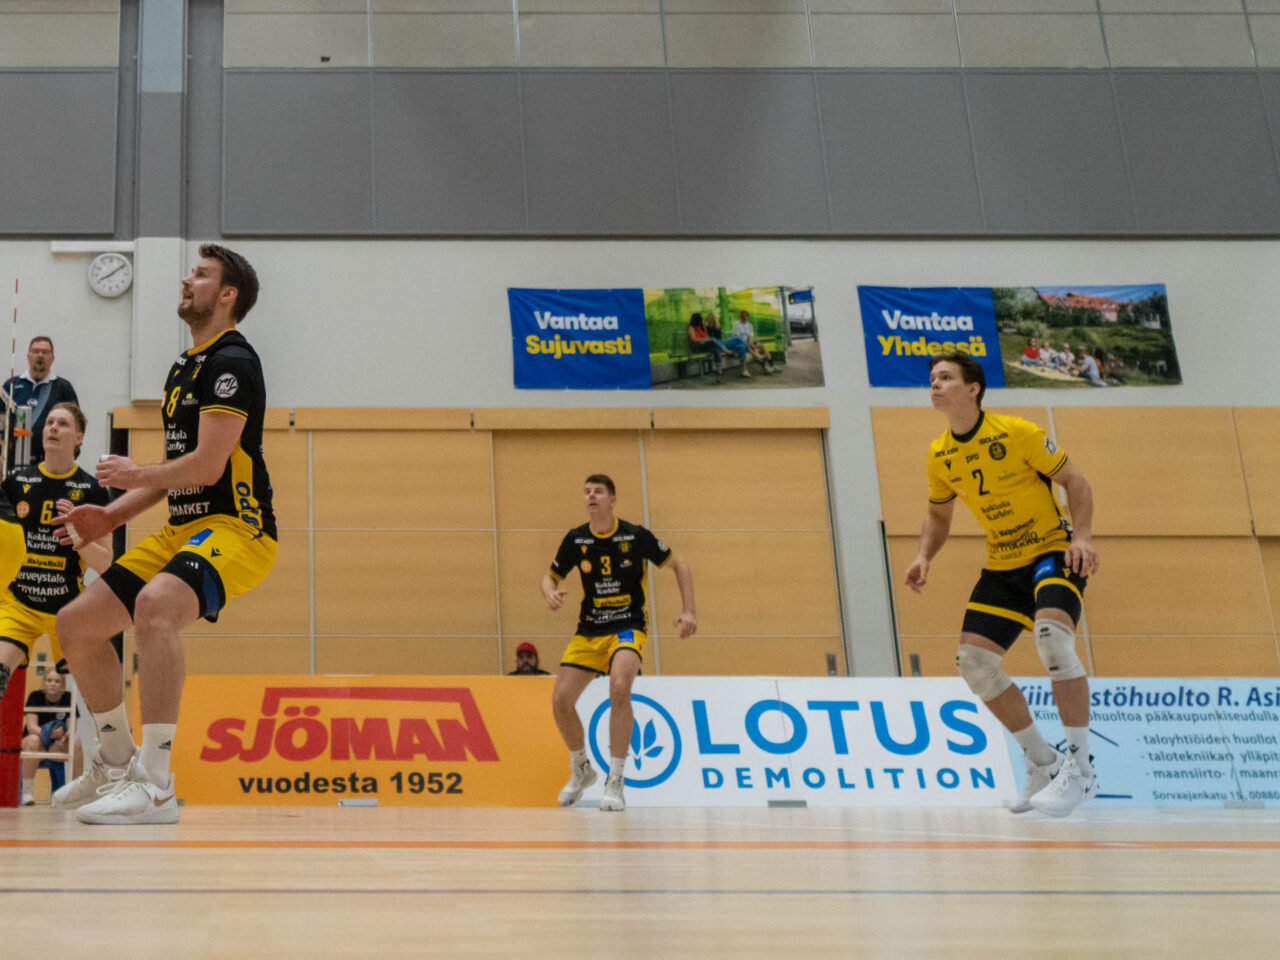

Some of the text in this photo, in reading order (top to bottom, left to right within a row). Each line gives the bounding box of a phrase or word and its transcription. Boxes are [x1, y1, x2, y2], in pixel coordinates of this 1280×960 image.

[534, 311, 619, 330] Vantaa
[882, 310, 974, 331] Vantaa
[525, 334, 632, 359] Sujuvasti
[877, 335, 987, 357] Yhdessä
[167, 386, 181, 418] 8
[972, 469, 989, 496] 2
[40, 500, 54, 524] 6
[600, 556, 611, 575] 3
[17, 571, 65, 584] erveystalo
[1218, 687, 1239, 707] R.
[1246, 687, 1280, 707] Asi
[200, 687, 501, 763] SJÖMAN
[692, 699, 988, 756] LOTUS
[1145, 711, 1279, 724] pääkaupunkiseudulla
[1143, 734, 1277, 747] taloyhtiöiden huollot
[1148, 751, 1280, 764] talotekniikan ylläpit
[238, 772, 464, 794] vuodesta 1952
[702, 767, 996, 789] DEMOLITION
